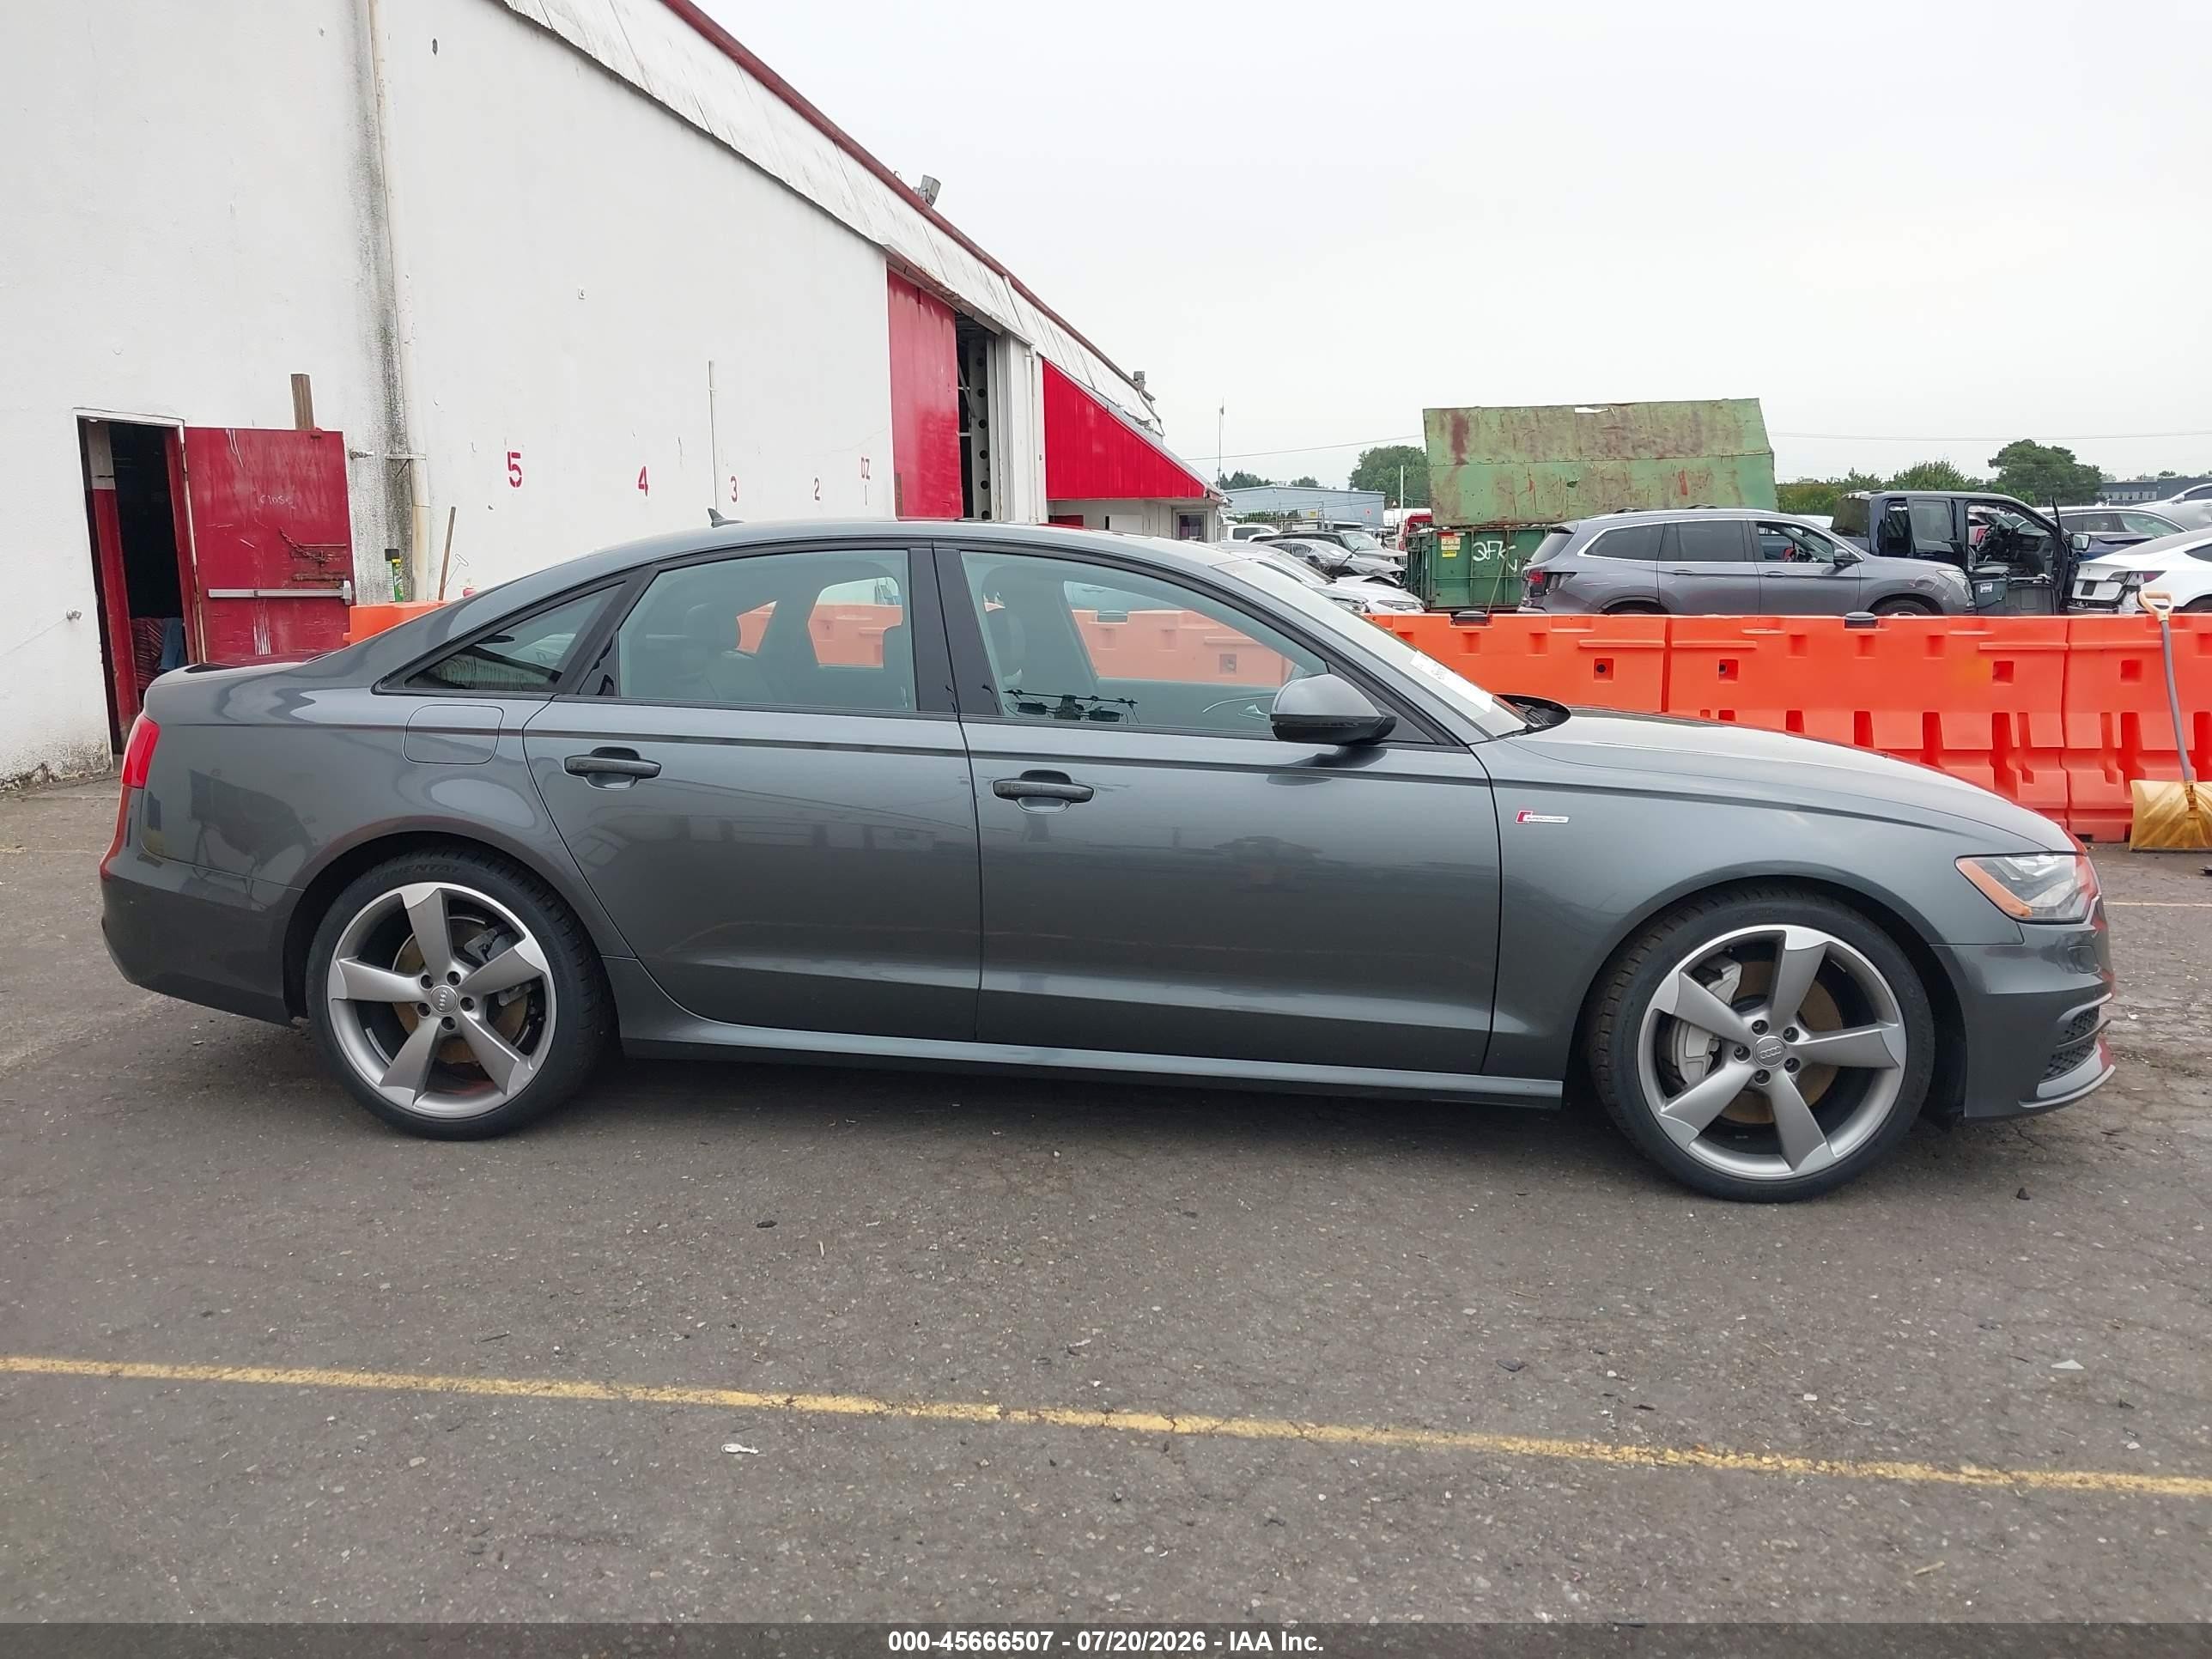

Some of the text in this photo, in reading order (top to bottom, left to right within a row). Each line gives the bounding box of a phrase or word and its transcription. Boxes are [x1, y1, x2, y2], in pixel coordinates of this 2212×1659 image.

[507, 452, 522, 488] 5
[638, 466, 648, 496] 4
[730, 476, 738, 502] 3
[814, 477, 820, 501] 2
